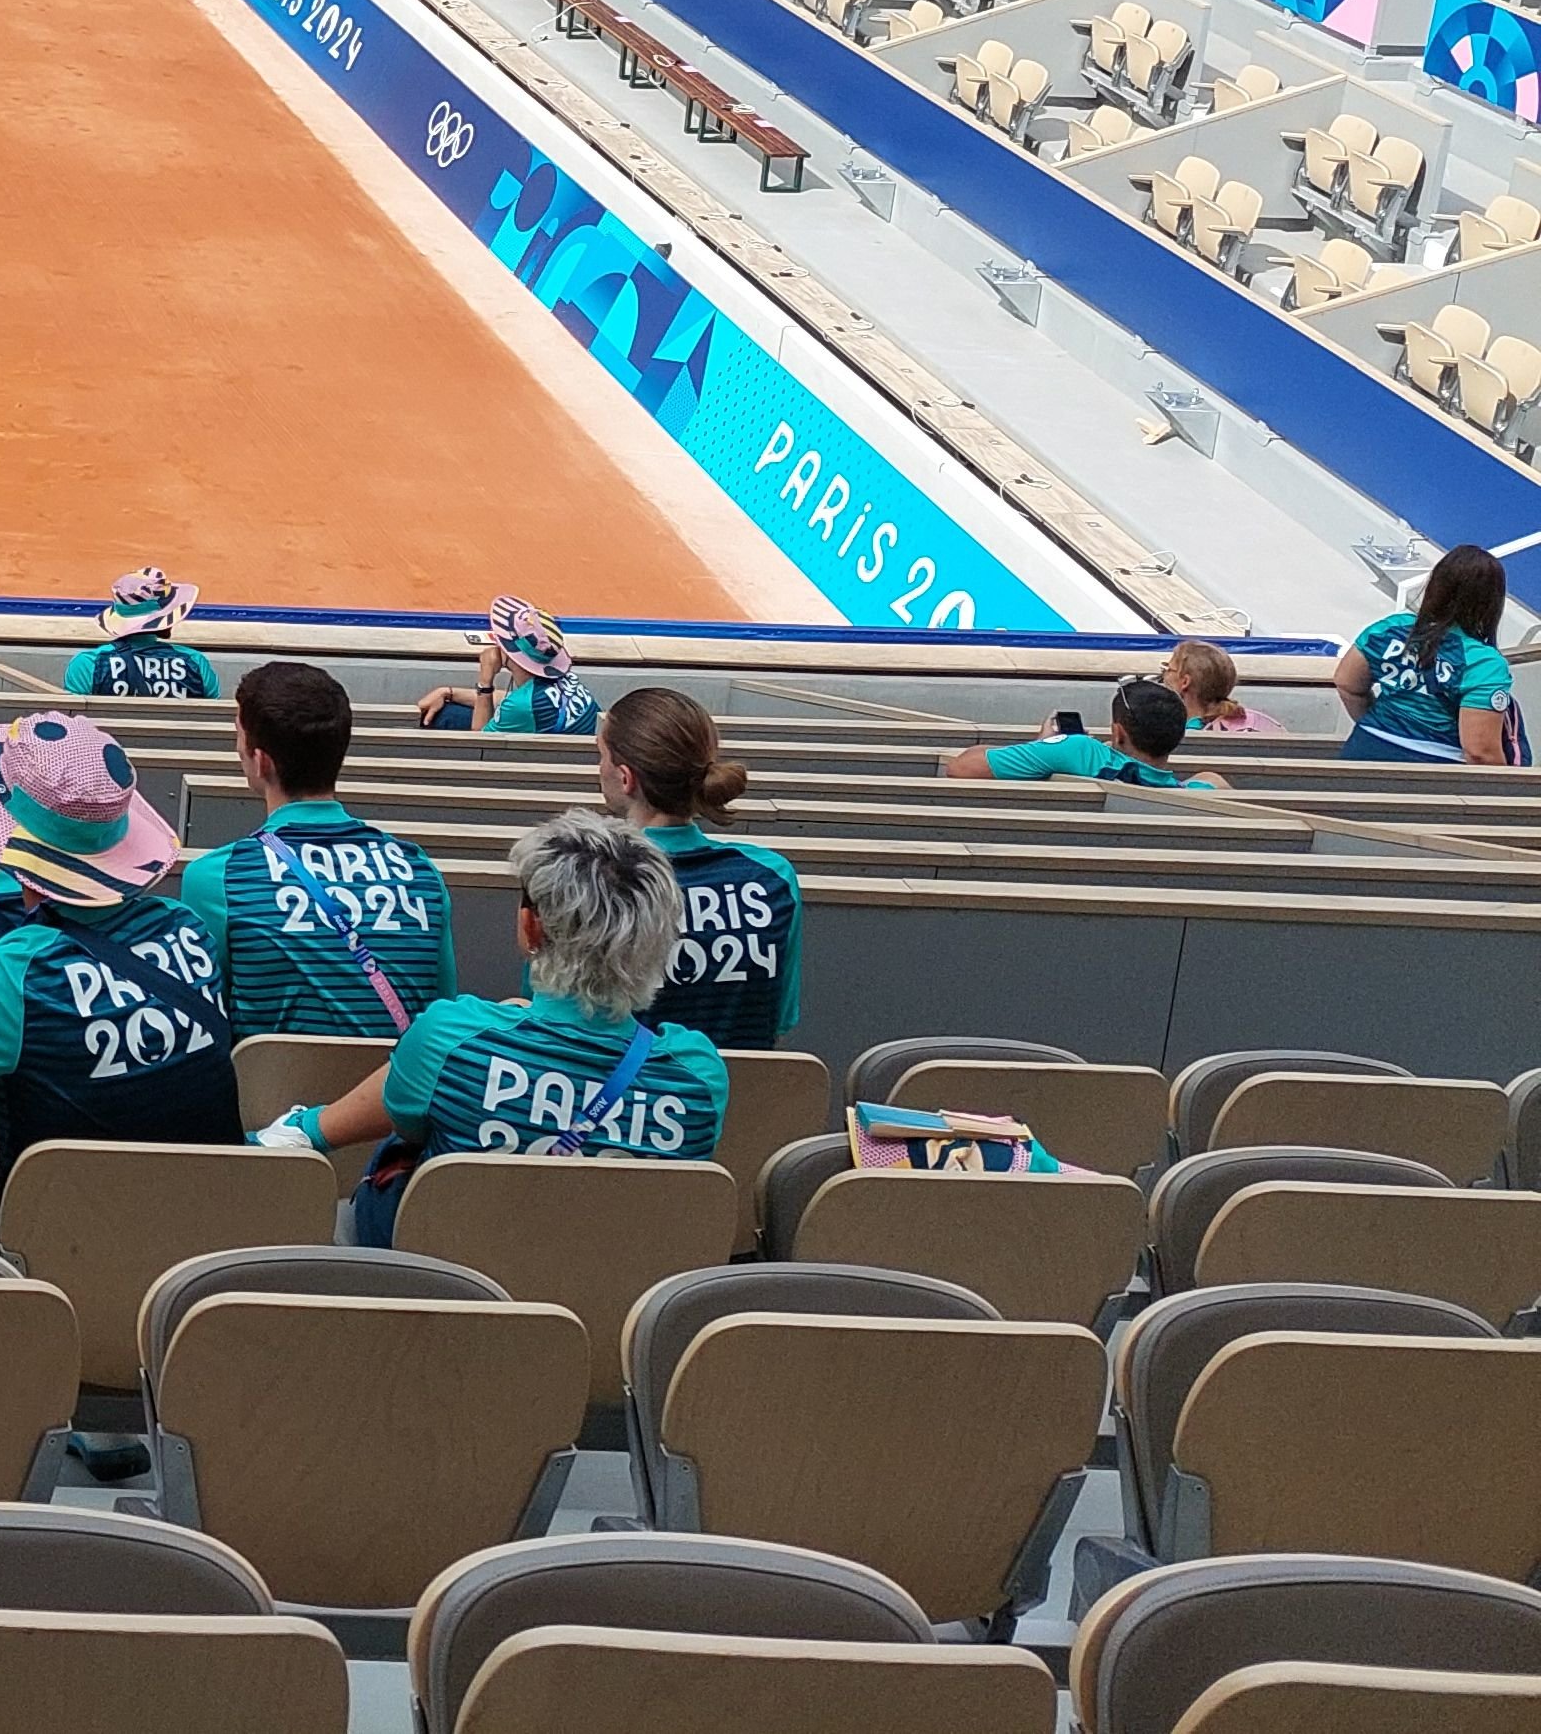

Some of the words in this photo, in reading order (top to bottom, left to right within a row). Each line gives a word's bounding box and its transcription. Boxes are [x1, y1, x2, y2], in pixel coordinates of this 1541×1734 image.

[753, 419, 899, 583] PARIS
[889, 556, 991, 630] 20
[109, 655, 187, 681] PRIS
[112, 680, 188, 699] 224
[262, 841, 414, 883] PARIS
[677, 881, 773, 934] RIS
[657, 933, 777, 987] 024
